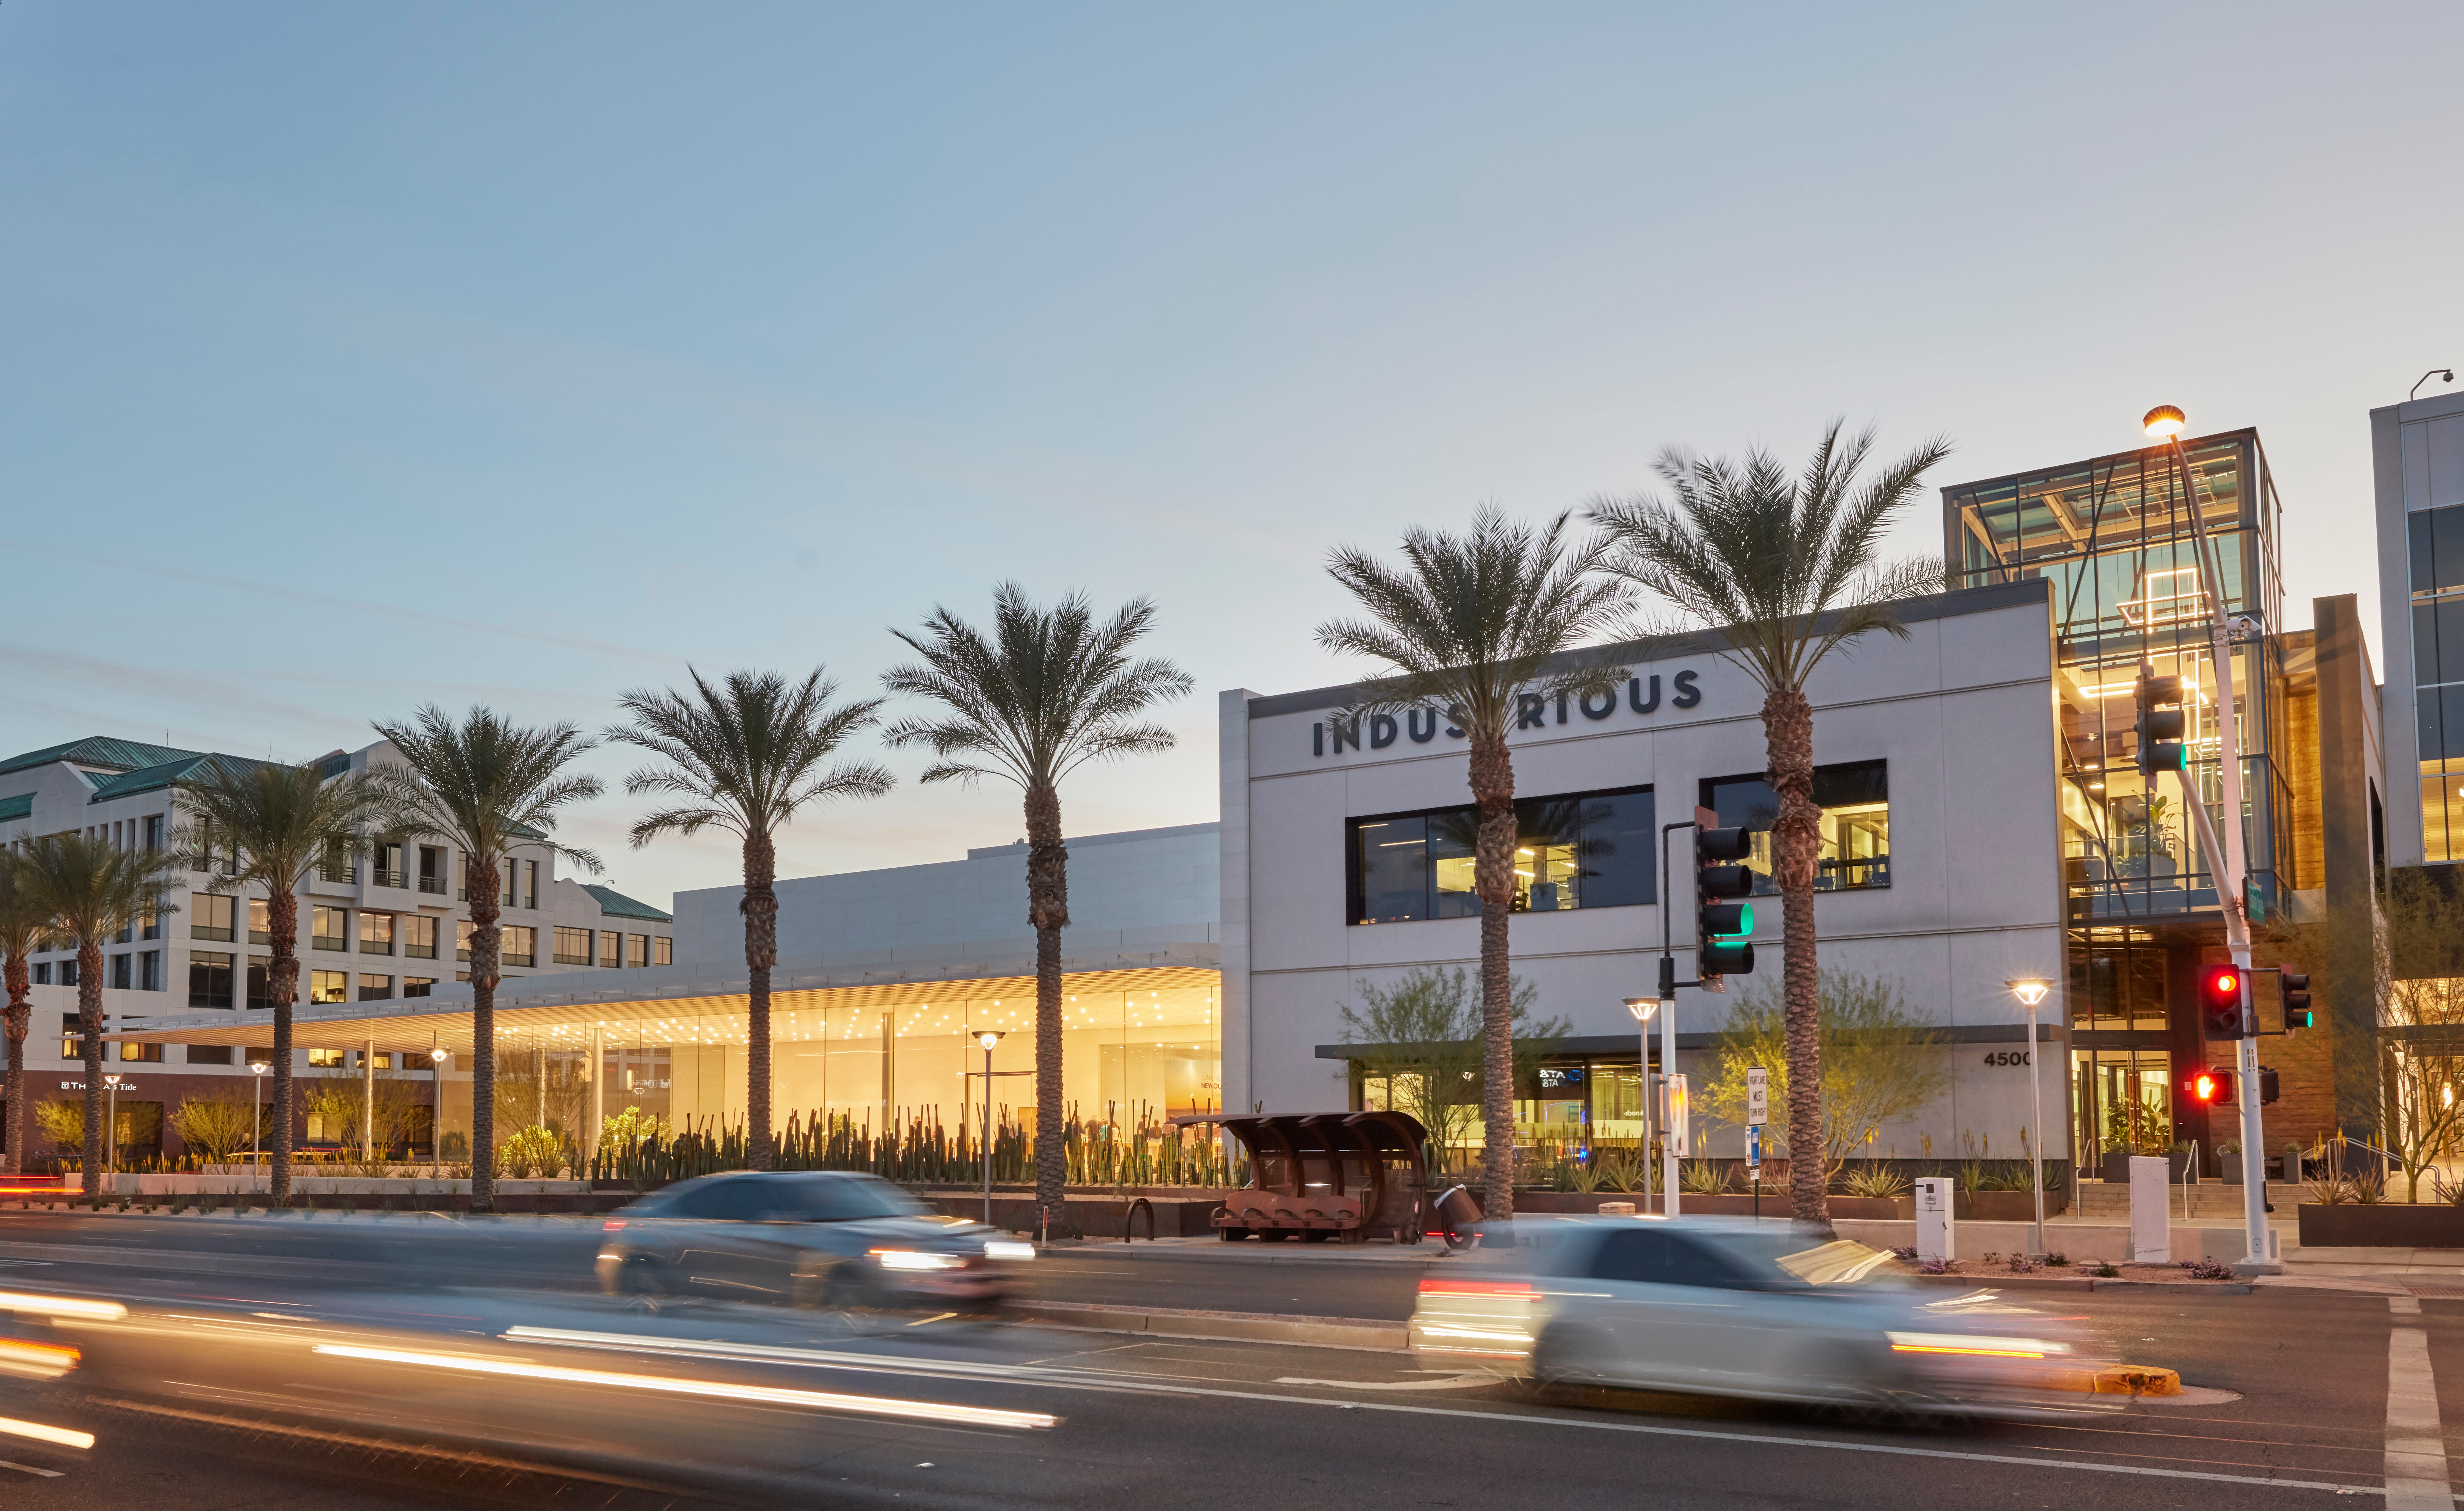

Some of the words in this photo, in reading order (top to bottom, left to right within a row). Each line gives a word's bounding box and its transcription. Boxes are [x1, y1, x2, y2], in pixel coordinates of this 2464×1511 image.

[1314, 670, 1701, 755] INDUSRIOUS
[1749, 1076, 1758, 1084] RIGHT
[1753, 1091, 1762, 1102] MUST
